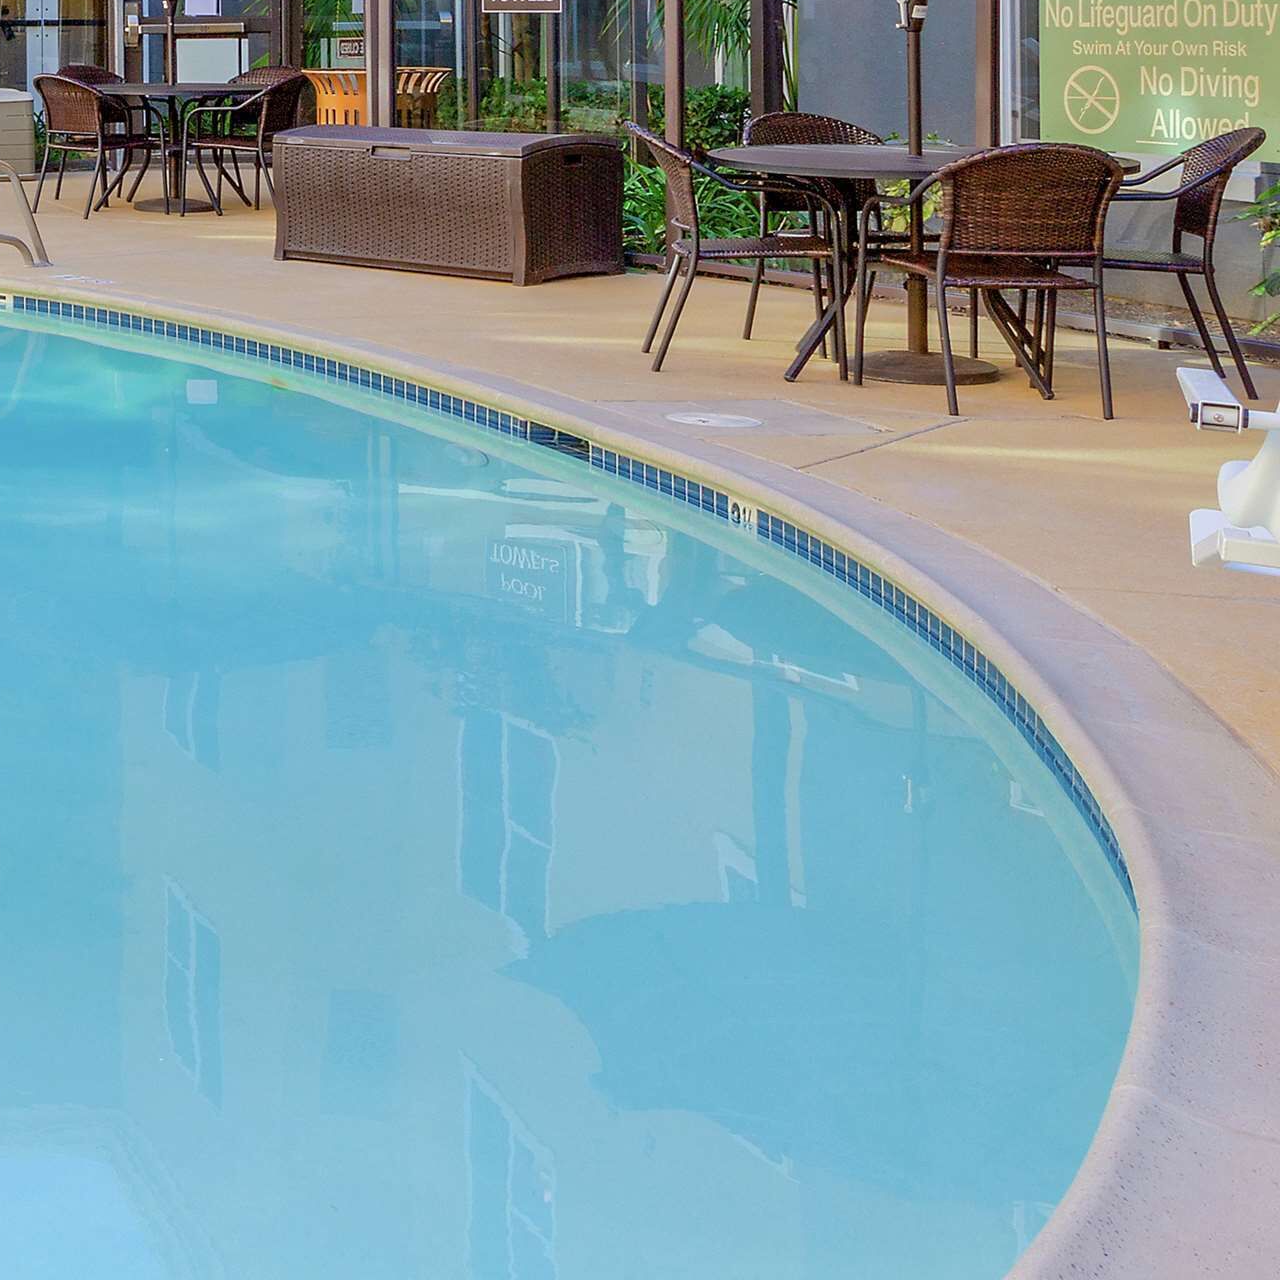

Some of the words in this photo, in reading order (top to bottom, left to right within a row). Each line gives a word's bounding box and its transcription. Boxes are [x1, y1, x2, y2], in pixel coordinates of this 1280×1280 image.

[1044, 0, 1073, 28] No
[1072, 40, 1112, 56] Swim
[1115, 40, 1131, 56] At
[1134, 40, 1168, 56] Your
[1171, 40, 1208, 56] Own
[1212, 41, 1248, 57] Risk
[1139, 66, 1174, 96] No
[1180, 66, 1260, 108] Diving
